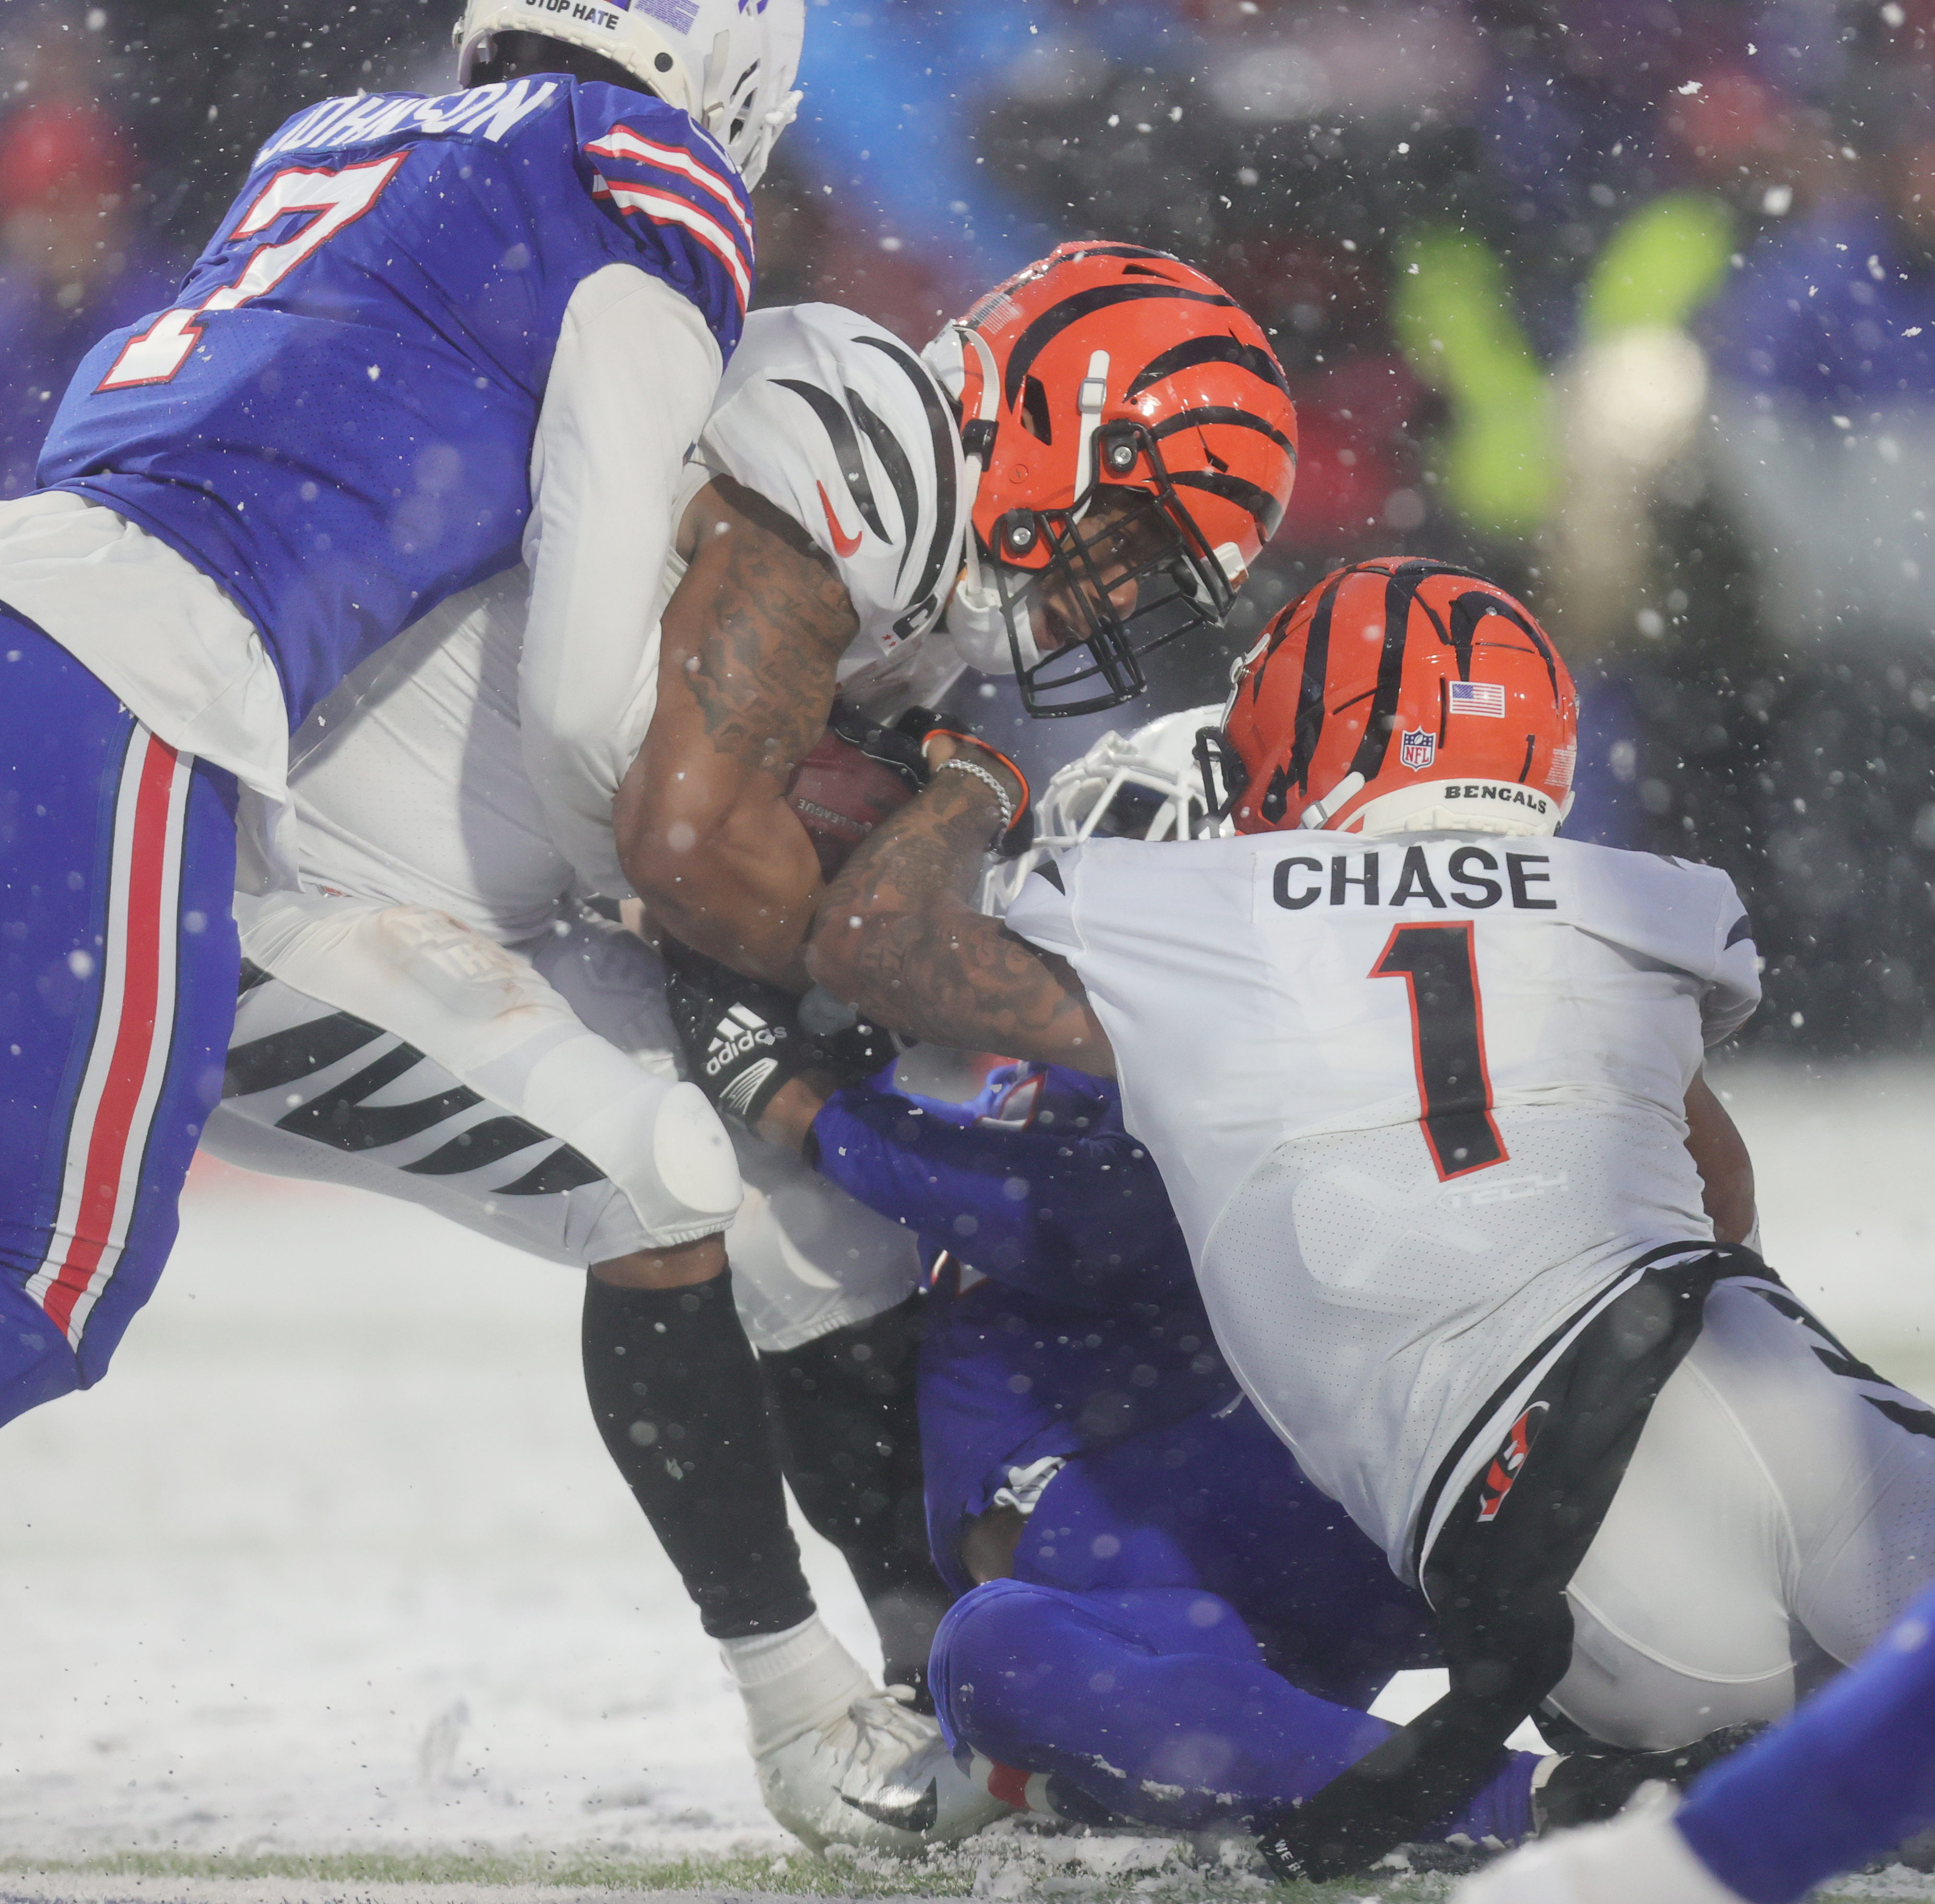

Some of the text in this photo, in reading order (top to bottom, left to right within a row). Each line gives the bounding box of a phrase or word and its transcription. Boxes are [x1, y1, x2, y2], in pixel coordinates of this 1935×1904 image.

[573, 3, 619, 30] HATE
[254, 79, 557, 168] JOHNSON
[91, 150, 411, 394] 7
[1405, 746, 1429, 764] NFL
[798, 798, 847, 826] LEAGUE
[1444, 786, 1547, 814] BENGALS
[1273, 846, 1557, 910] CHASE
[707, 1026, 787, 1075] adidas
[1367, 920, 1510, 1182] 1
